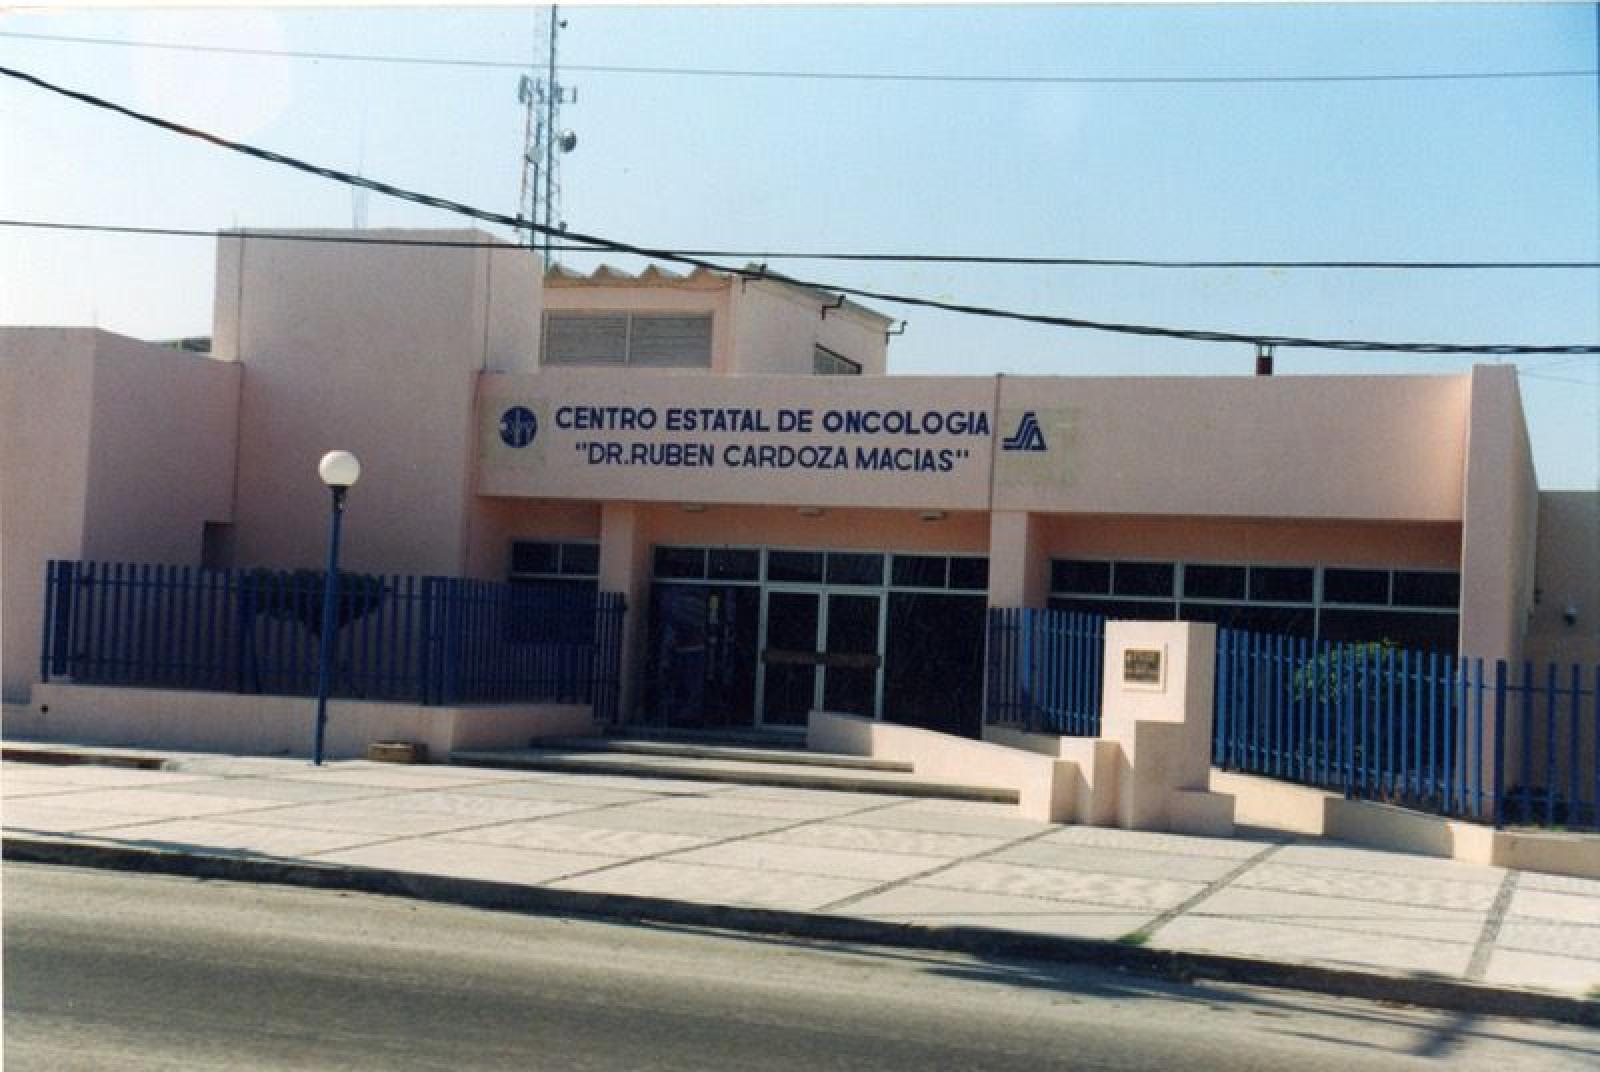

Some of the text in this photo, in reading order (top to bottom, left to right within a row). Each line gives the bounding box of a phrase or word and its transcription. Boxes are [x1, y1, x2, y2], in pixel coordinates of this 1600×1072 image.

[555, 405, 657, 431] CENTRO
[665, 408, 770, 432] ESTATAL
[777, 409, 814, 432] DE
[822, 411, 991, 435] ONCOLOGIA
[723, 444, 849, 469] CARDOZA
